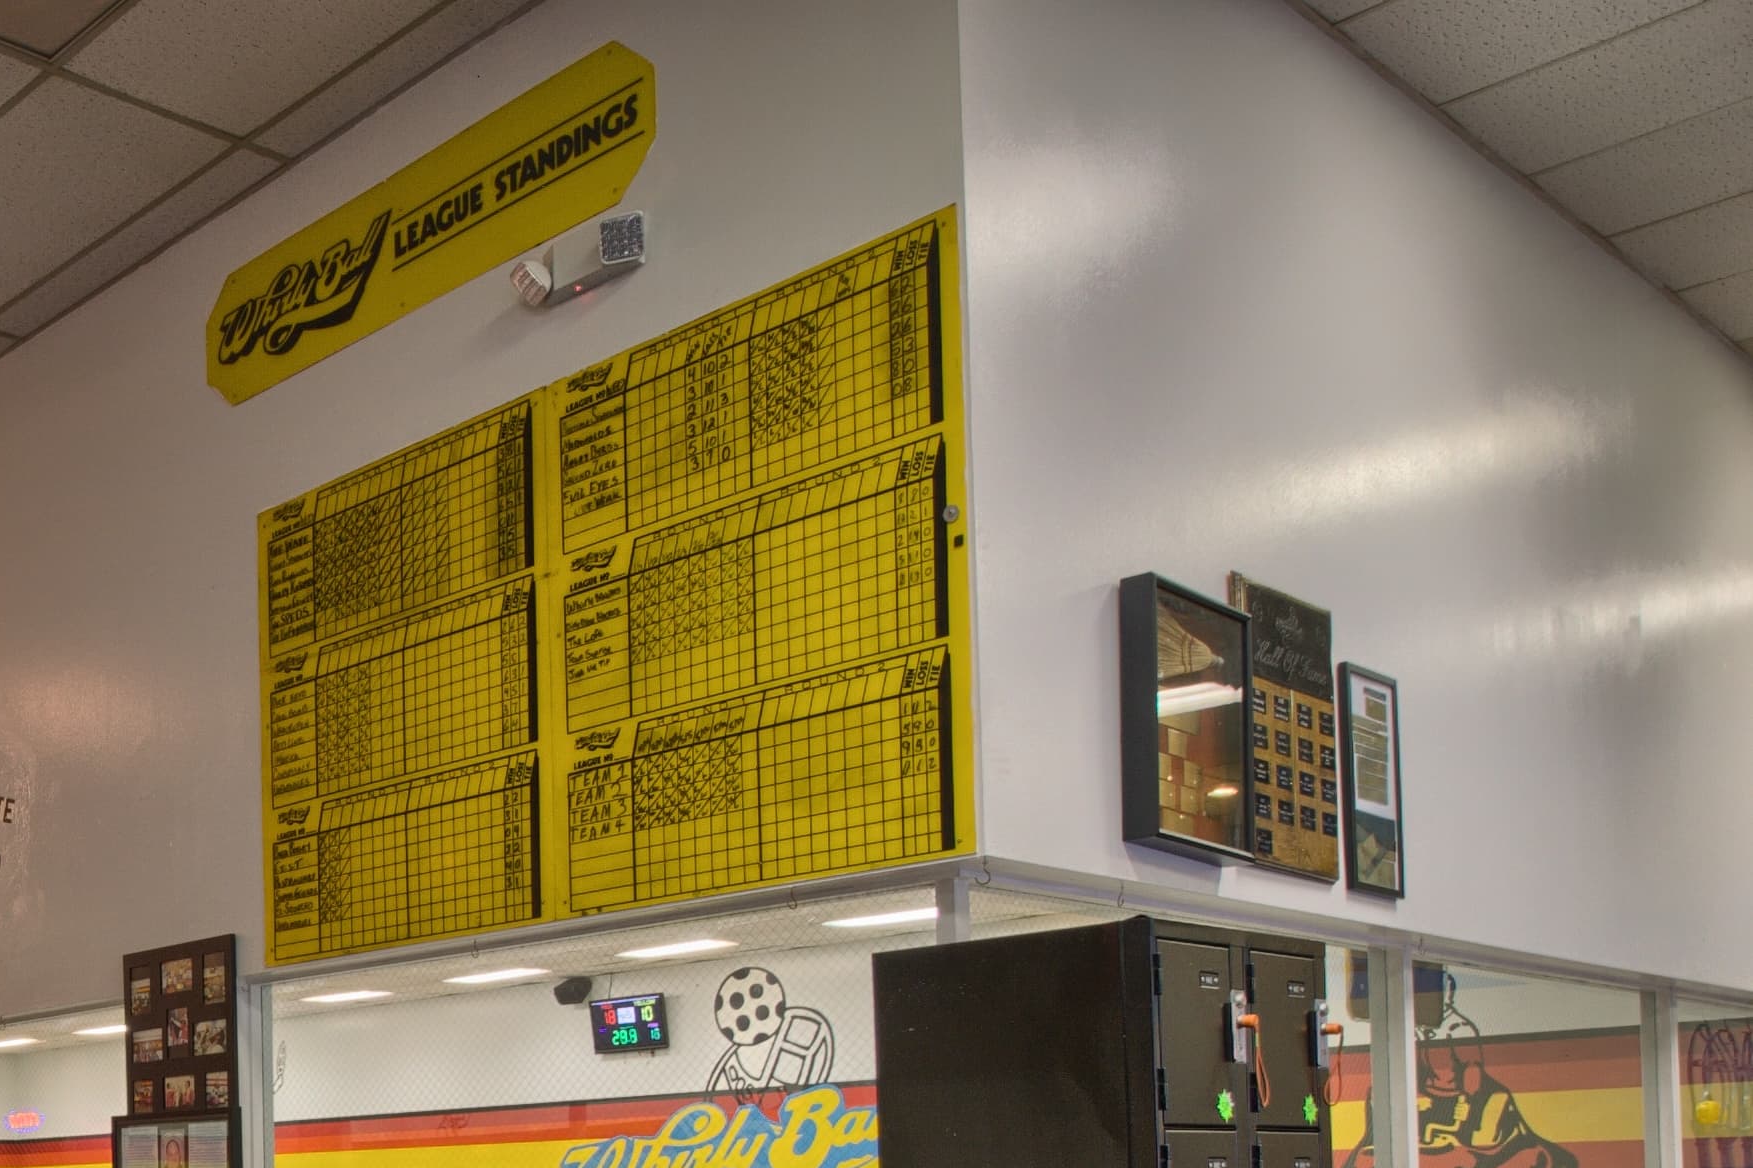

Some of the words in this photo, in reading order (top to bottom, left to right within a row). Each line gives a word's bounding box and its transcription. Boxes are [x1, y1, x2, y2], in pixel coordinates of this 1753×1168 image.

[393, 183, 484, 259] LEAGUE
[494, 95, 638, 203] STANDINGS
[566, 394, 593, 412] LEAGUE
[916, 661, 928, 685] LOSS
[569, 767, 611, 792] TEAM
[568, 784, 606, 807] TEAM
[570, 802, 611, 824] TEAM
[570, 822, 610, 844] TEAM
[640, 1005, 654, 1022] 10
